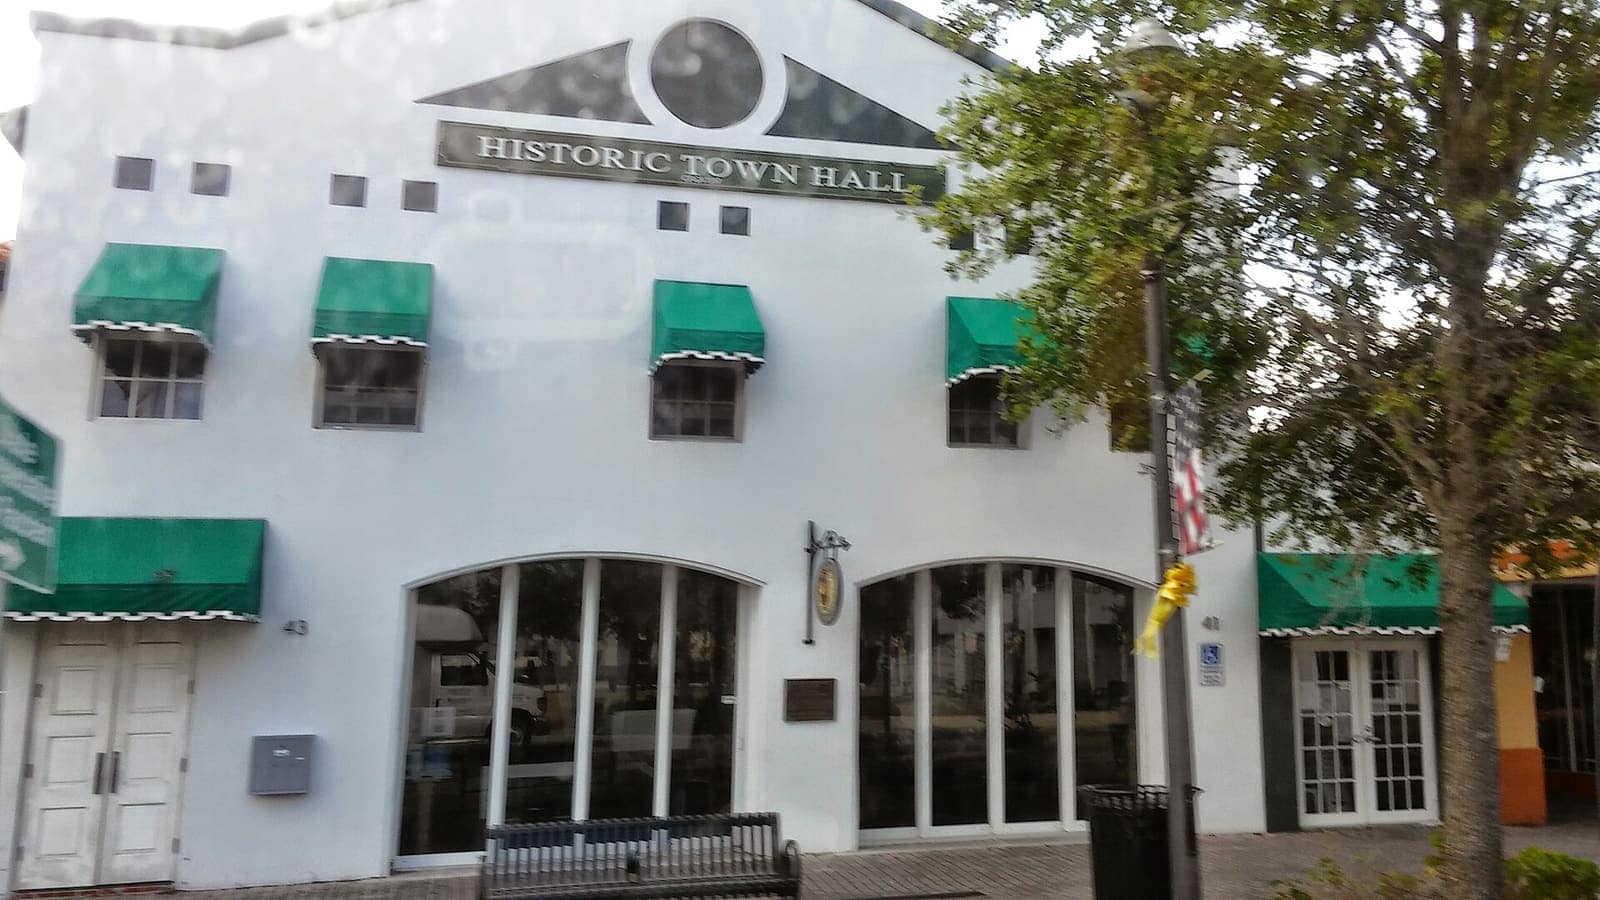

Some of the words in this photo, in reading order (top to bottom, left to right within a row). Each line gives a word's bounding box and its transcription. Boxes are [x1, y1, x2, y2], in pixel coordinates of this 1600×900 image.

[477, 136, 672, 173] HISTORIC
[680, 154, 800, 186] TOWN
[809, 166, 912, 194] HALL
[283, 620, 309, 636] 43
